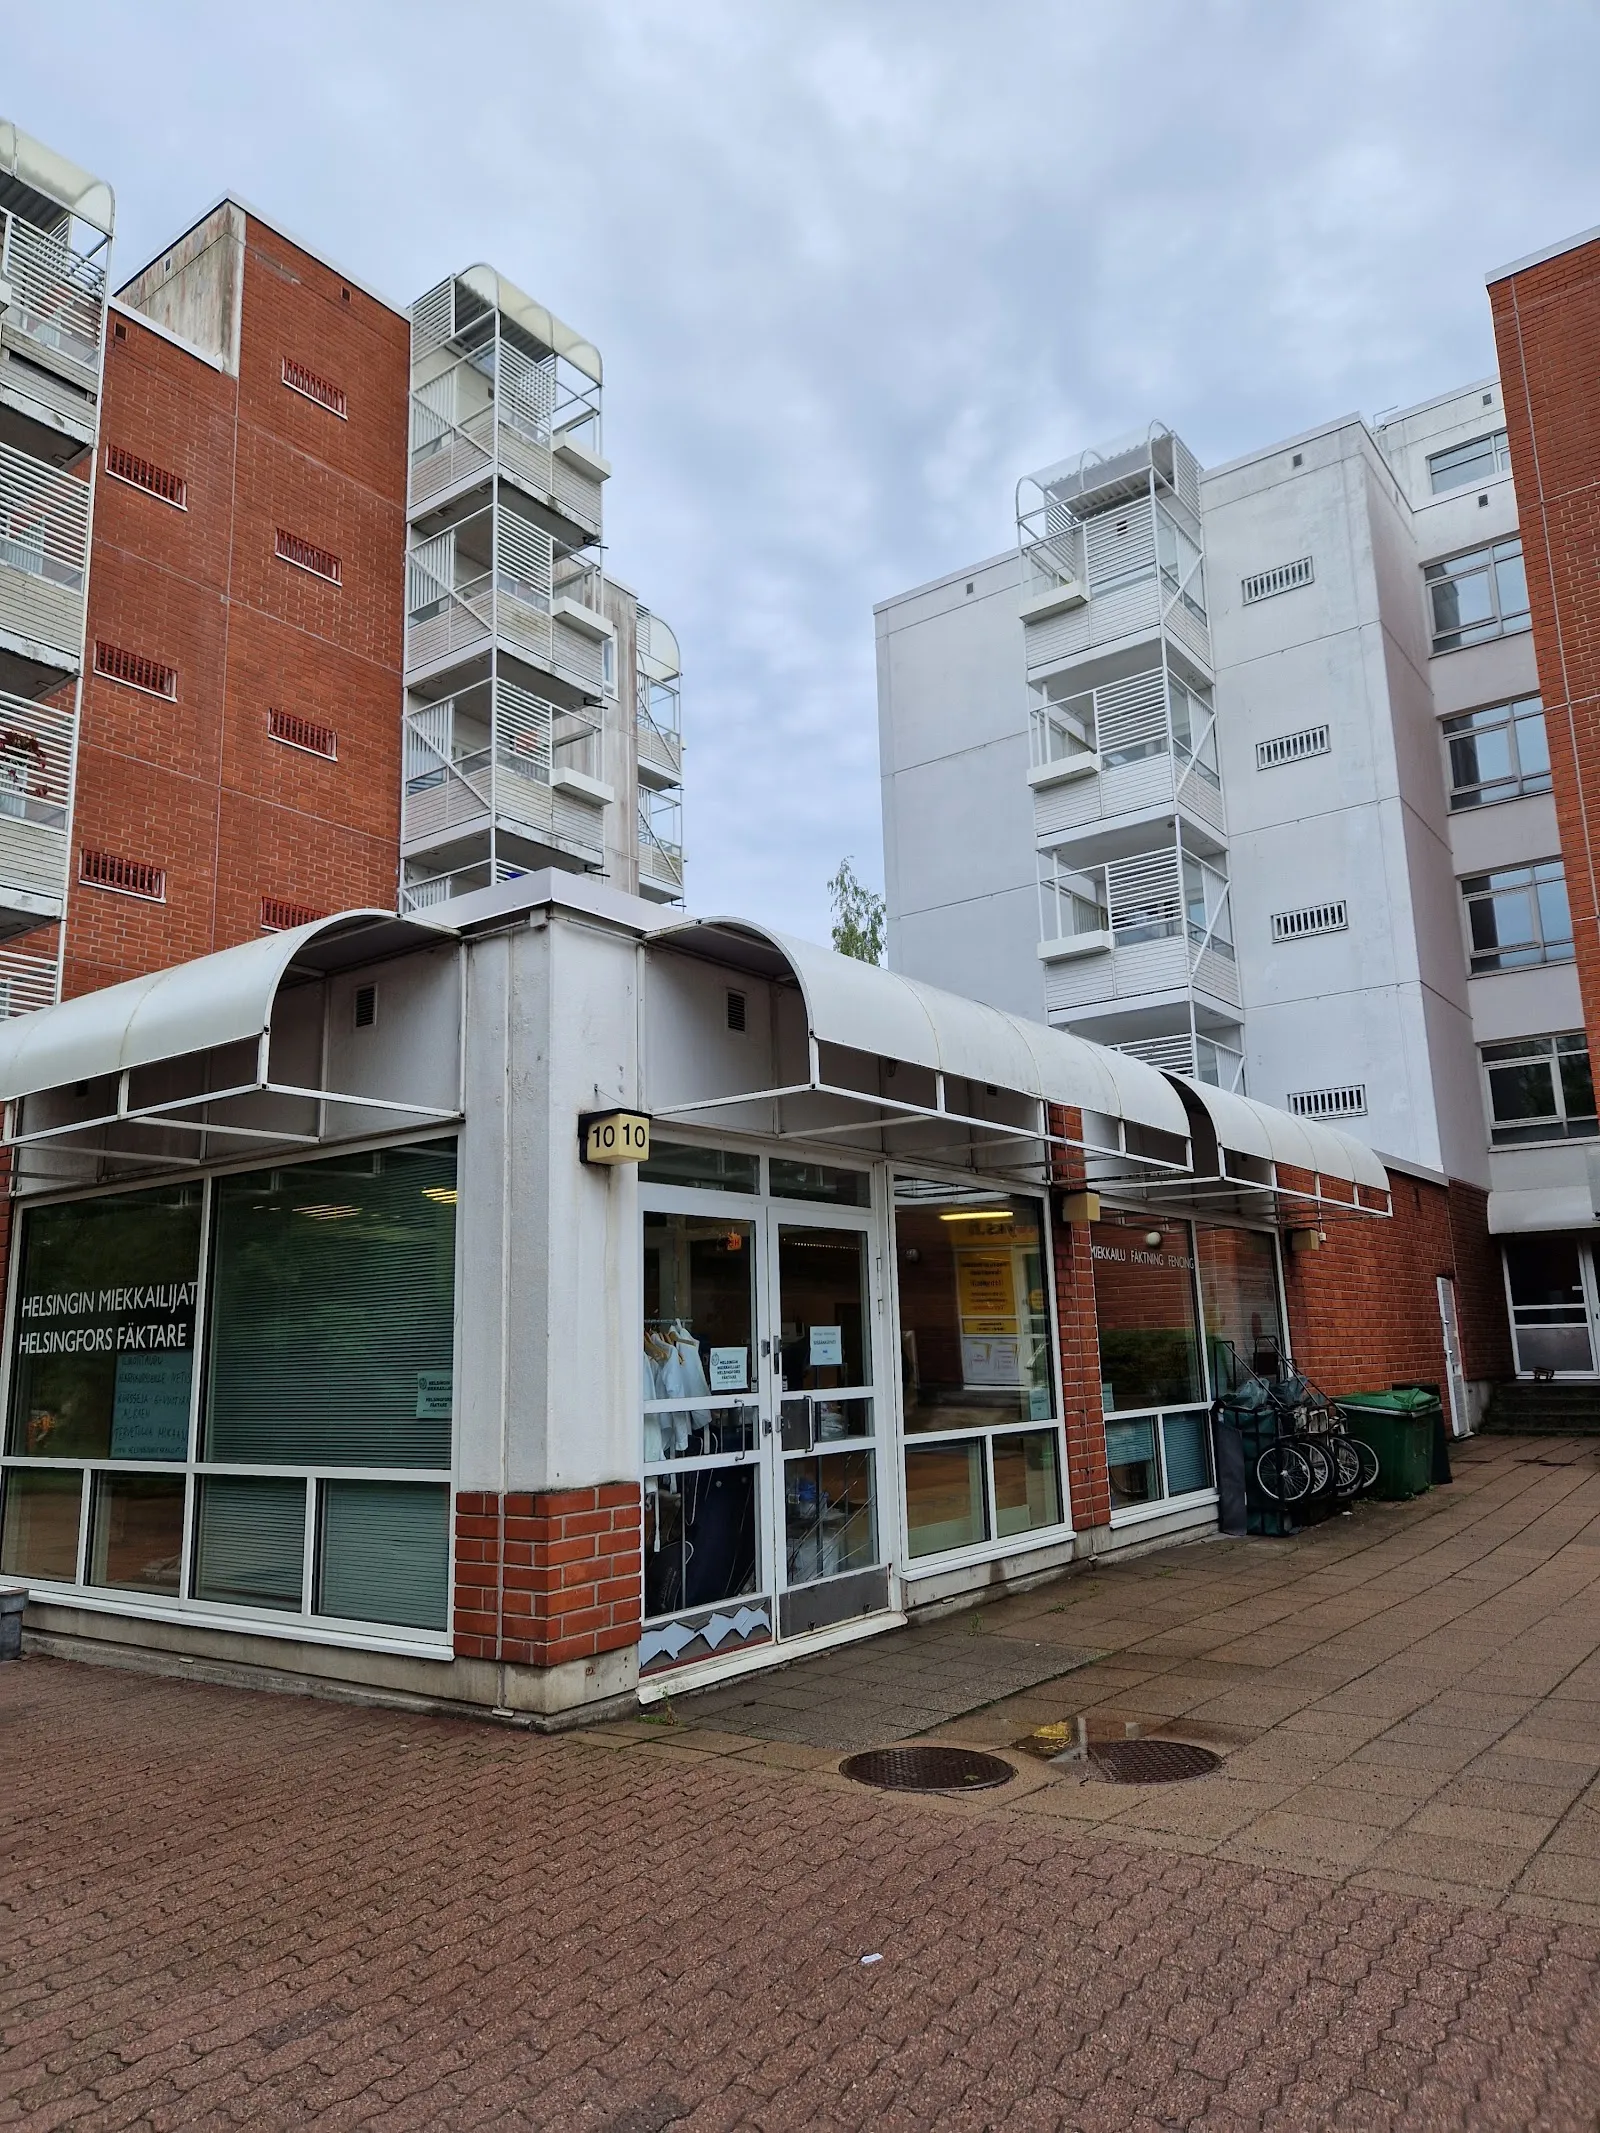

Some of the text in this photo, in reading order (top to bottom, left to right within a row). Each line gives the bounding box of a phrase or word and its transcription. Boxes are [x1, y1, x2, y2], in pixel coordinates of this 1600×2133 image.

[592, 1125, 615, 1148] 10
[622, 1123, 646, 1148] 10
[1091, 1245, 1195, 1270] MIEKKAILU FÄKTNING FENCING
[21, 1281, 199, 1319] HELSINGIN MIEKKAILIJAT
[18, 1322, 187, 1355] HELSINGFORS FÄKTARE
